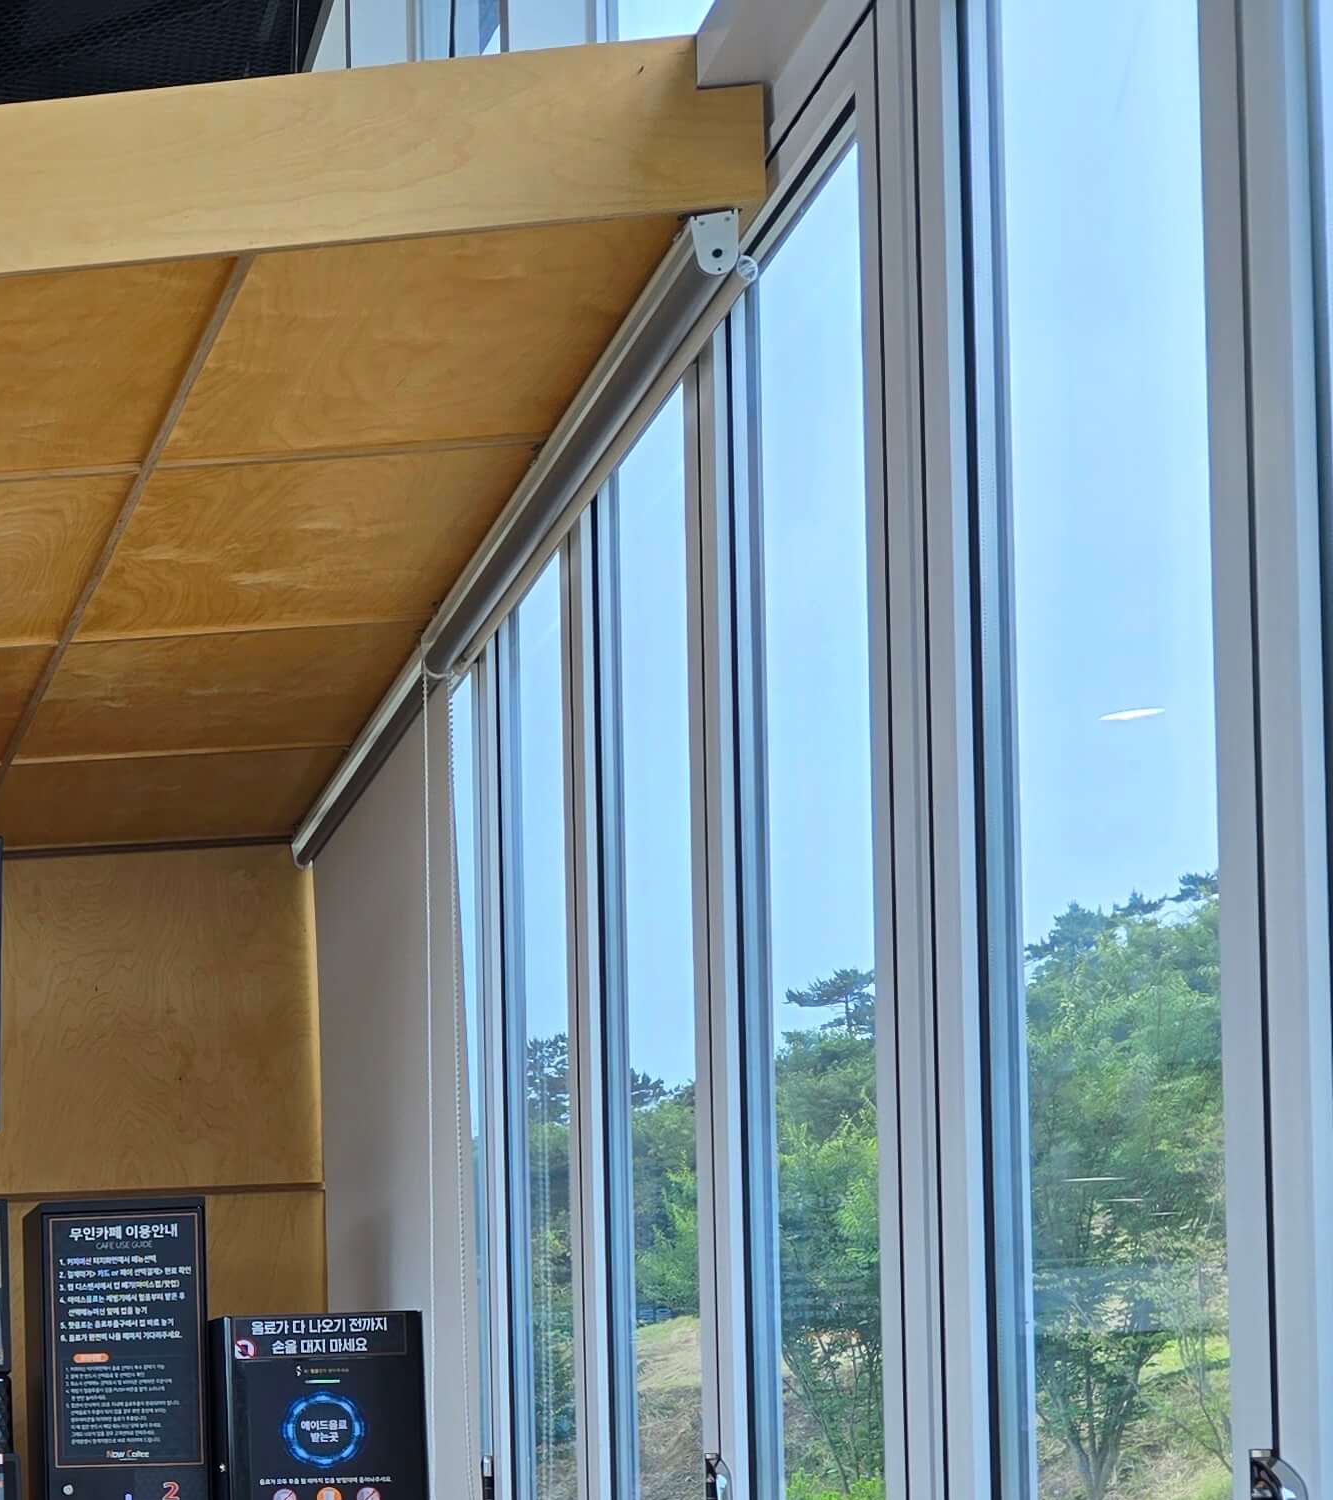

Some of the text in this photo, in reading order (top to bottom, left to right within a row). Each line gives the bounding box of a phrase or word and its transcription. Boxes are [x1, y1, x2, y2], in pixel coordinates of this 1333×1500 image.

[69, 1223, 178, 1240] 무인카페 이용안내
[95, 1240, 152, 1250] CAFE USE GUIDE
[251, 1317, 387, 1335] 음료가 다 나오기 전까지
[272, 1338, 367, 1354] 손을 대지 마세요
[301, 1420, 348, 1431] 에이드음료
